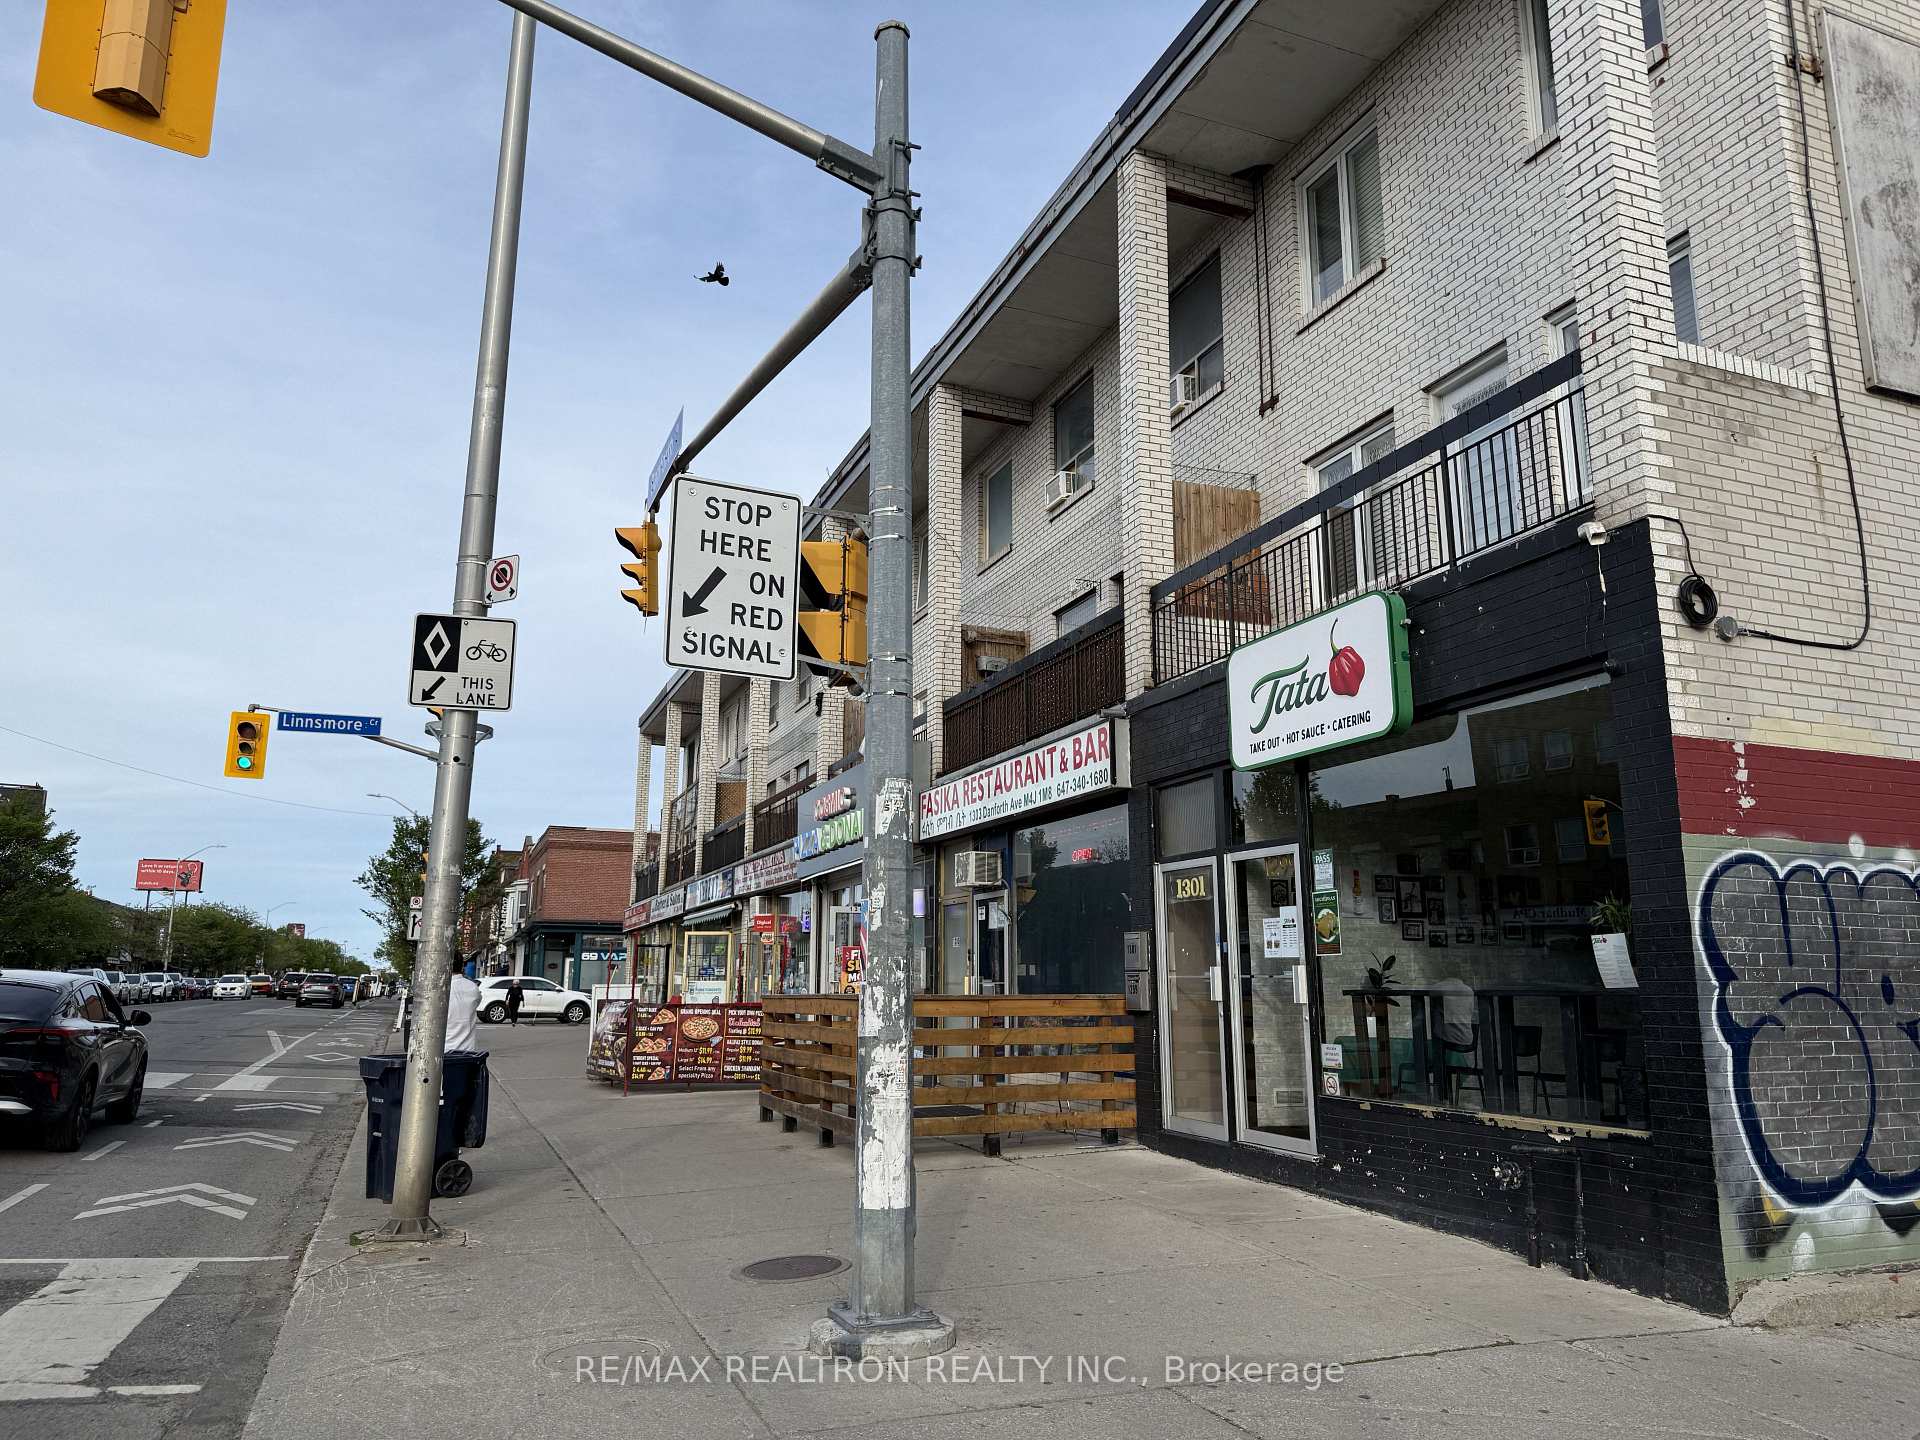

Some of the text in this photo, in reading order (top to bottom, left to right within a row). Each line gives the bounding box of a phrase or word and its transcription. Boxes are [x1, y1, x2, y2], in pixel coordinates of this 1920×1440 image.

[704, 496, 772, 527] STOP
[700, 529, 772, 563] HERE
[749, 571, 785, 598] ON
[730, 603, 783, 631] RED
[681, 631, 781, 666] SIGNAL
[461, 676, 494, 691] THIS
[1249, 654, 1330, 735] Tata
[456, 692, 496, 707] LANE
[282, 713, 379, 731] Linnsmore Cr
[1249, 710, 1371, 755] TAKE OUT HOT SAUCE CATERING
[920, 783, 960, 820] FASIKA
[963, 745, 1057, 806] RESTAURANT
[1060, 746, 1069, 773] &
[1072, 727, 1110, 771] BAR
[982, 799, 1008, 819] Danforth
[1009, 795, 1023, 811] Ave
[1023, 789, 1037, 807] M4J
[1039, 785, 1053, 803] 1M8
[1056, 767, 1109, 798] 647-340-1680
[1315, 854, 1331, 864] PASS
[1175, 875, 1206, 899] 1301
[581, 952, 599, 961] 69
